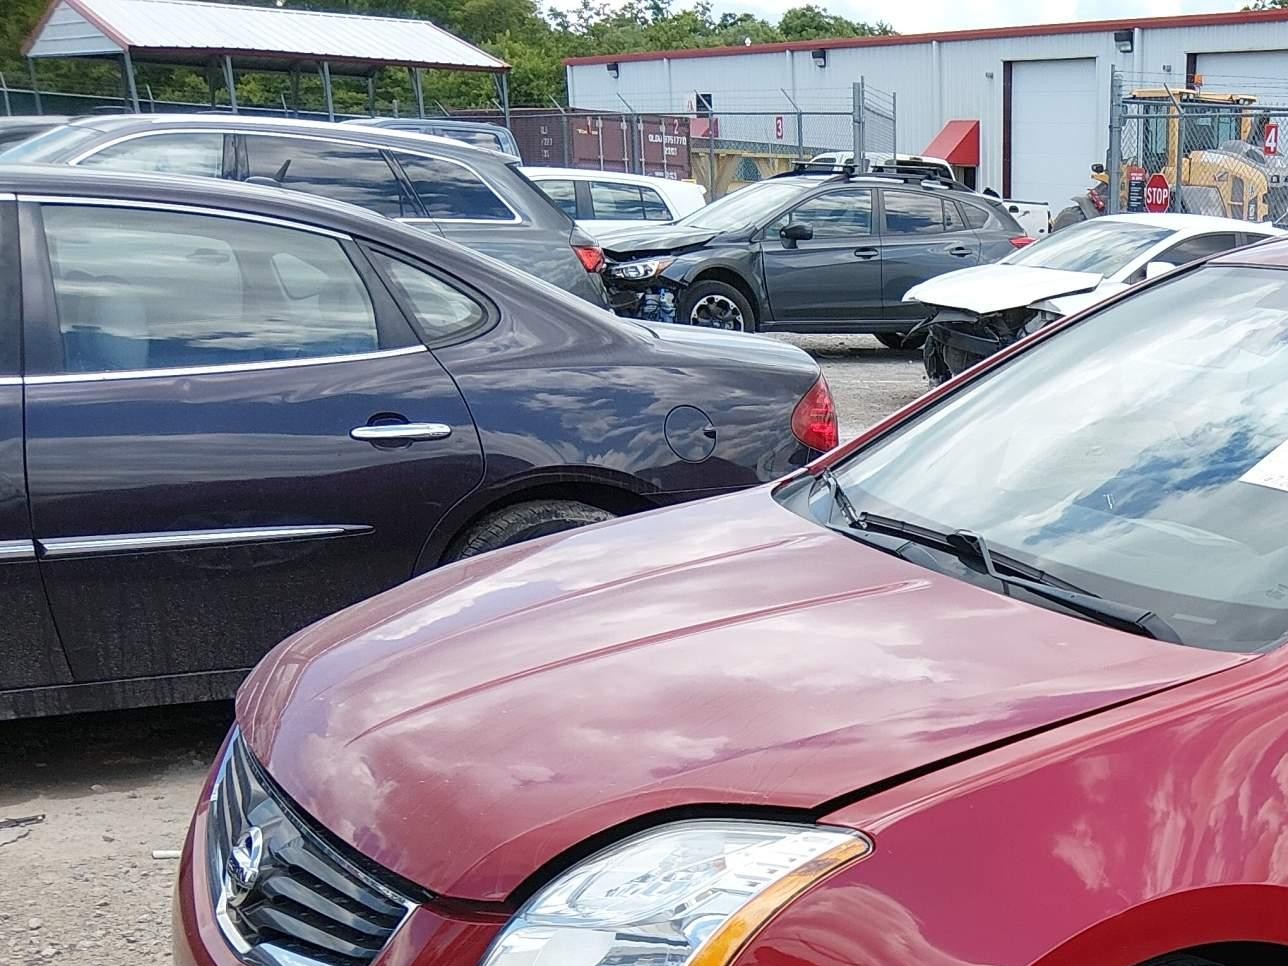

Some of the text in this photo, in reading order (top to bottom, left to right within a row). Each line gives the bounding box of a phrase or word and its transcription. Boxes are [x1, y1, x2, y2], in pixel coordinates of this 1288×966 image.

[673, 118, 679, 135] 2
[776, 119, 783, 137] 3
[1265, 127, 1277, 152] 4
[1146, 187, 1169, 205] STOP
